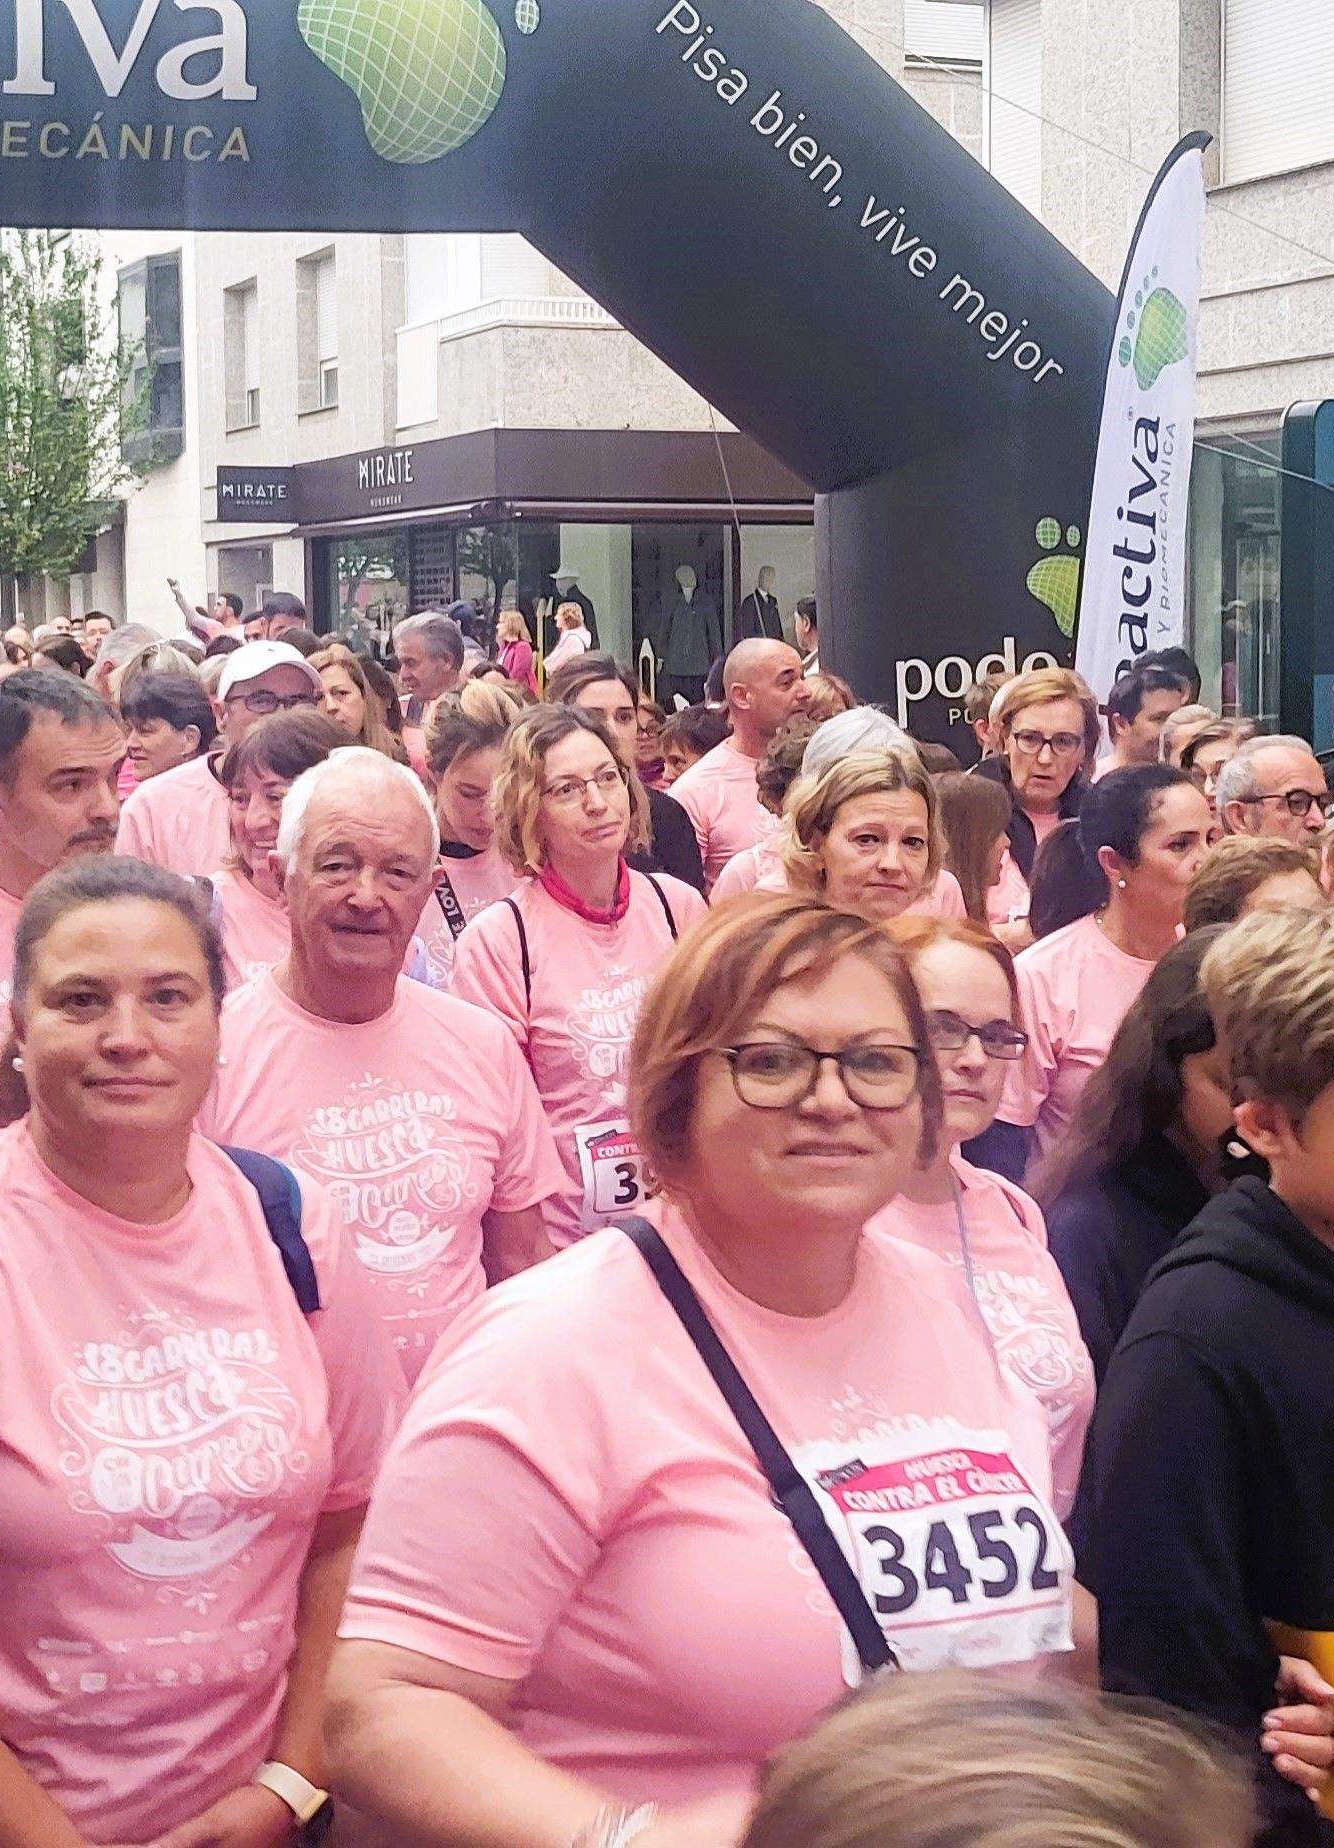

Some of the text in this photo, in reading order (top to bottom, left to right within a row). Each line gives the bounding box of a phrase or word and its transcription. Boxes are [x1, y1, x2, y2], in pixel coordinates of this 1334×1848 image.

[655, 0, 1064, 383] Pisa bien, vive mejor
[358, 450, 414, 490] MIRATE
[222, 484, 287, 499] MIRATE
[841, 1481, 935, 1512] CONTRA
[862, 1506, 1059, 1614] 3452
